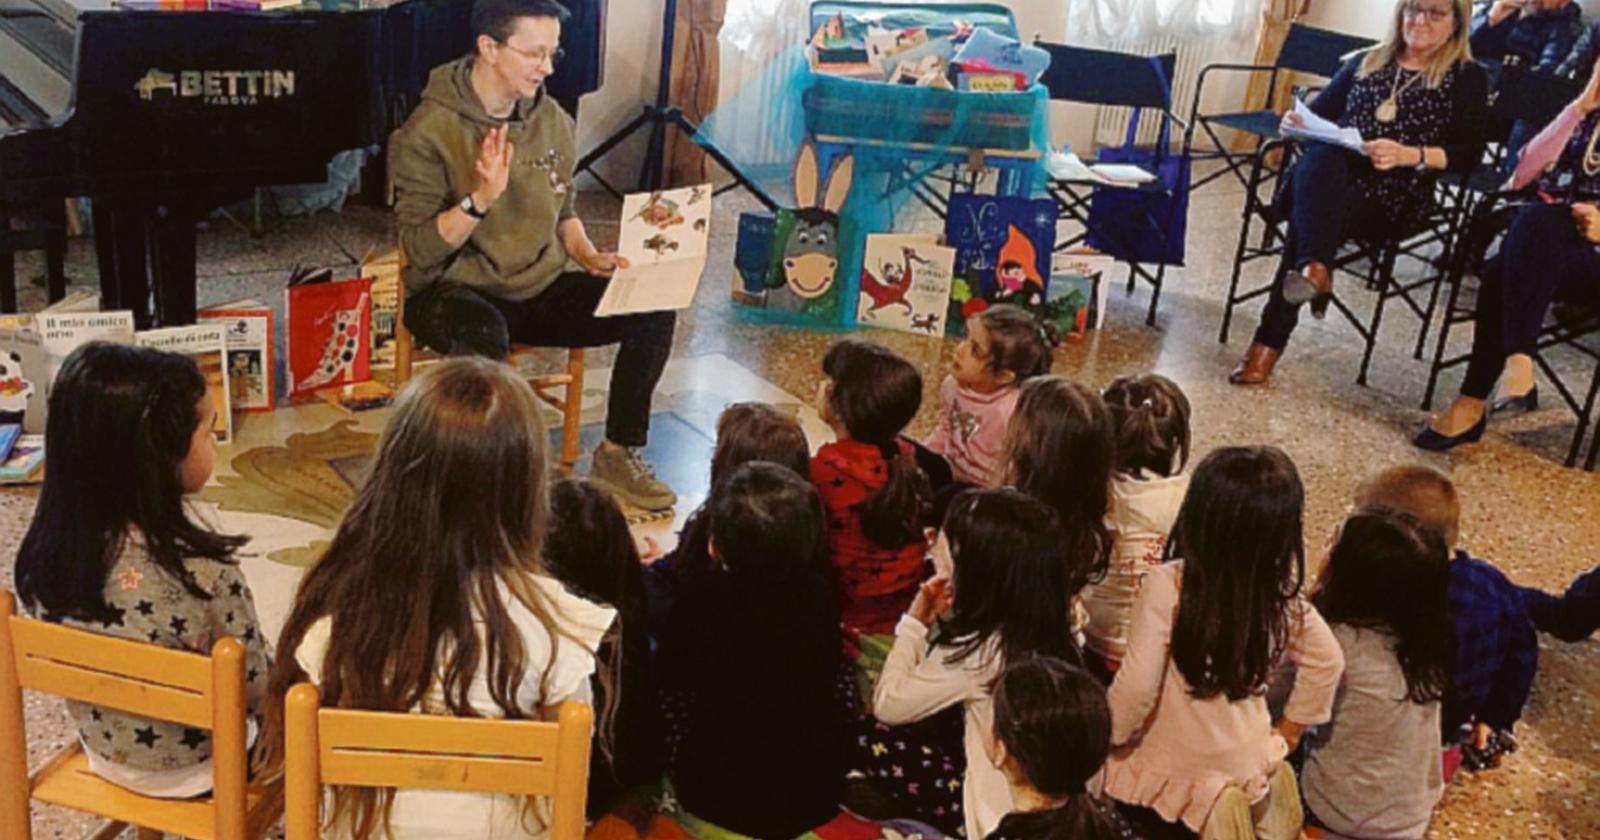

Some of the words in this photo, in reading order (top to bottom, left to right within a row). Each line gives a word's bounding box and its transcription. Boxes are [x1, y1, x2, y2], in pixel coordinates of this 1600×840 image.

[203, 96, 258, 104] PADOVA
[60, 318, 85, 329] mio
[88, 316, 127, 328] amico
